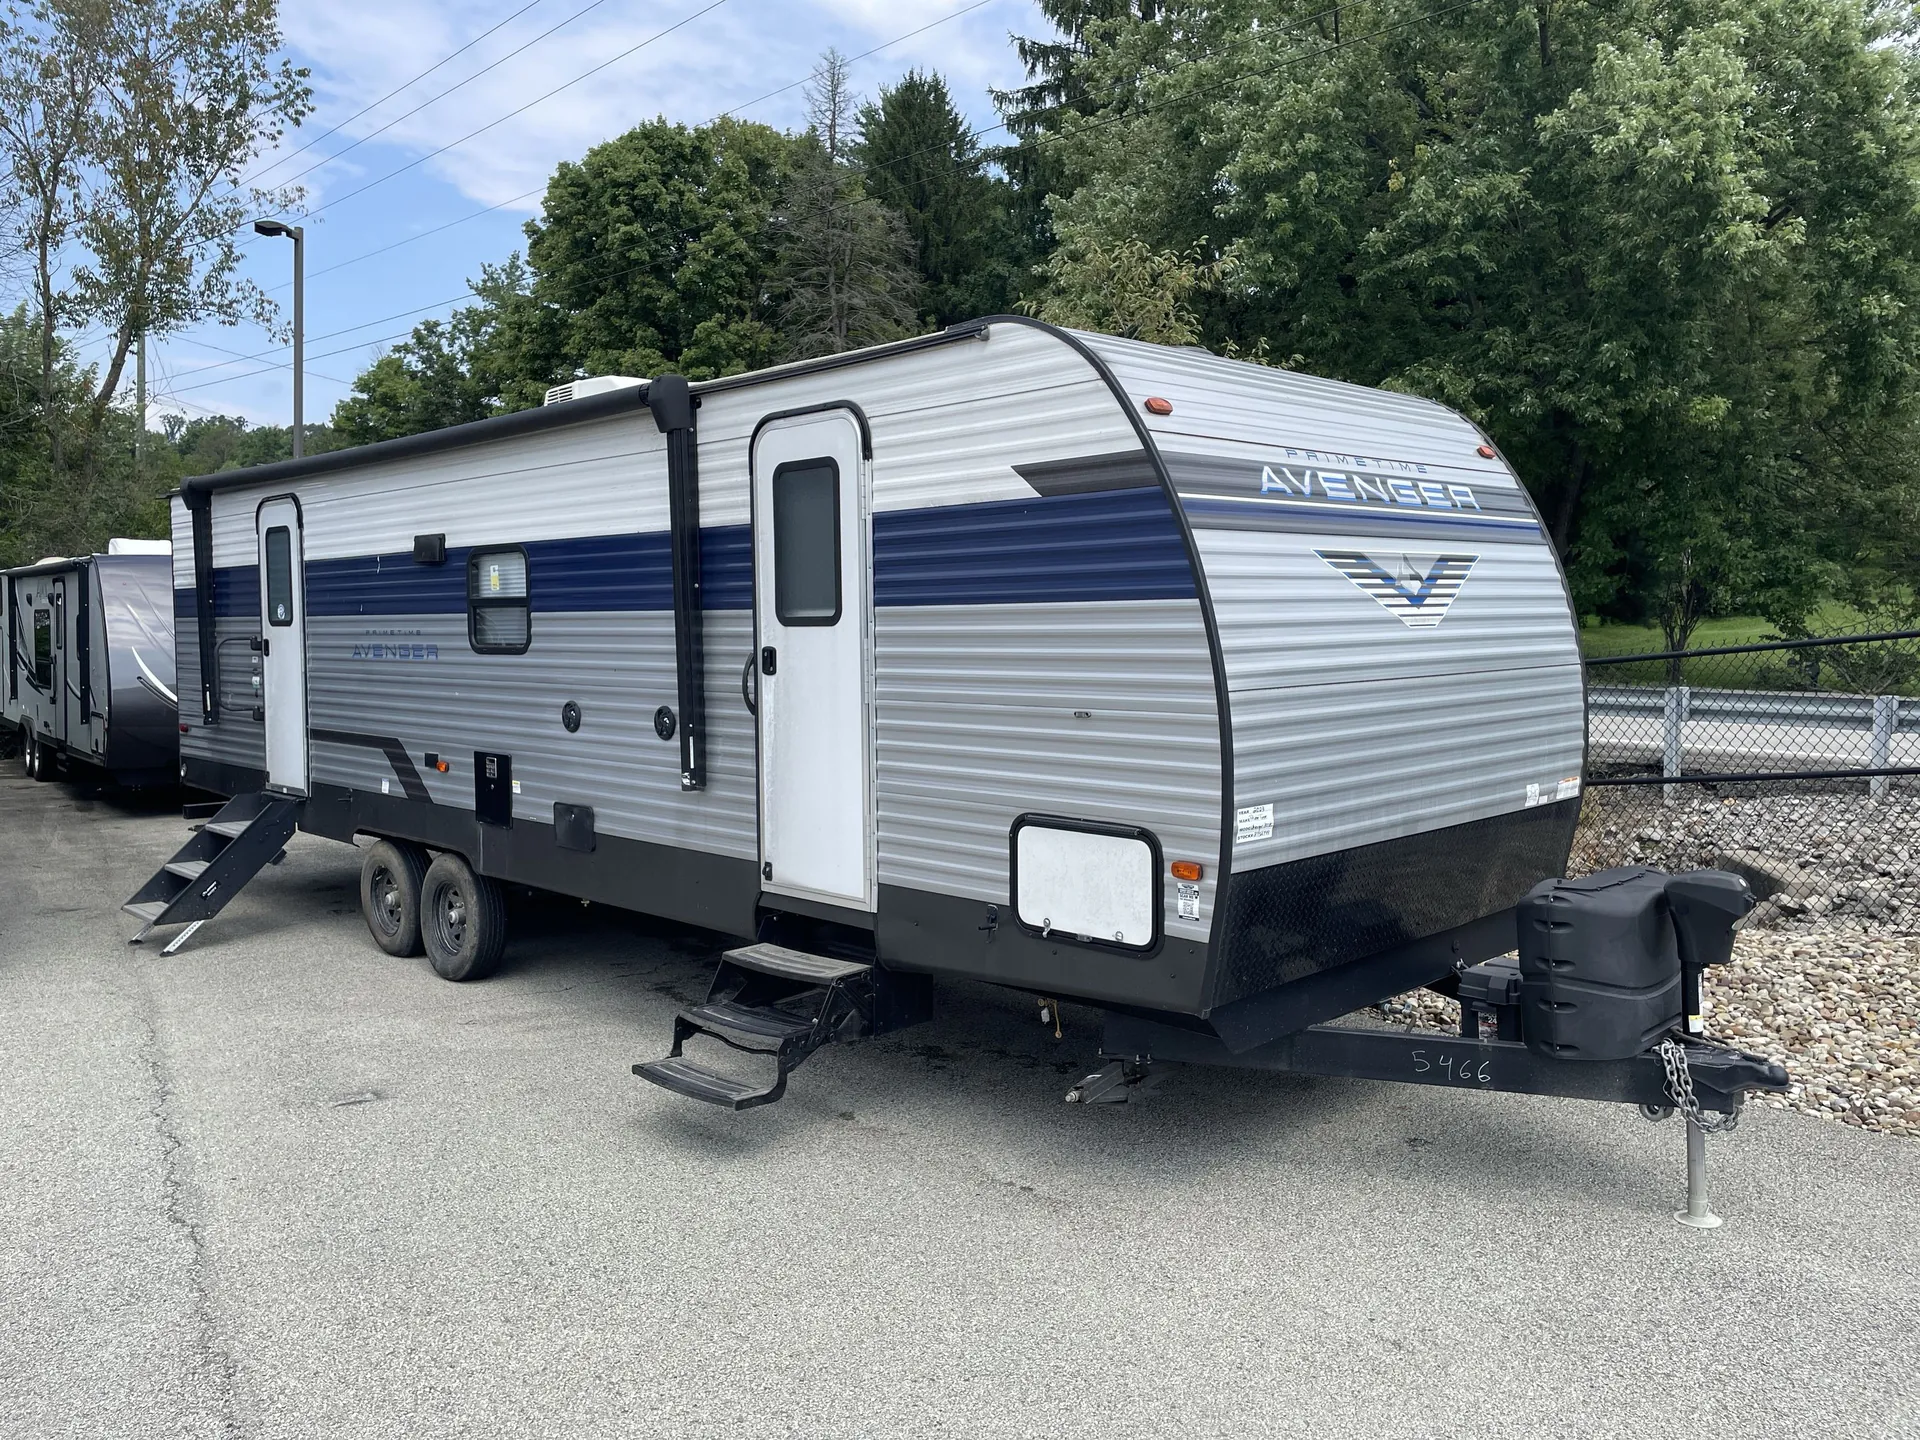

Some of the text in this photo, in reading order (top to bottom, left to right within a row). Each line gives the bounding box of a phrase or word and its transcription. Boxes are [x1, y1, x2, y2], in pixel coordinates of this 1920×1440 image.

[1285, 449, 1428, 474] PRIMETIME
[1260, 465, 1482, 512] AVENGER
[352, 643, 439, 660] AVENGER
[1411, 1050, 1491, 1082] 5466
